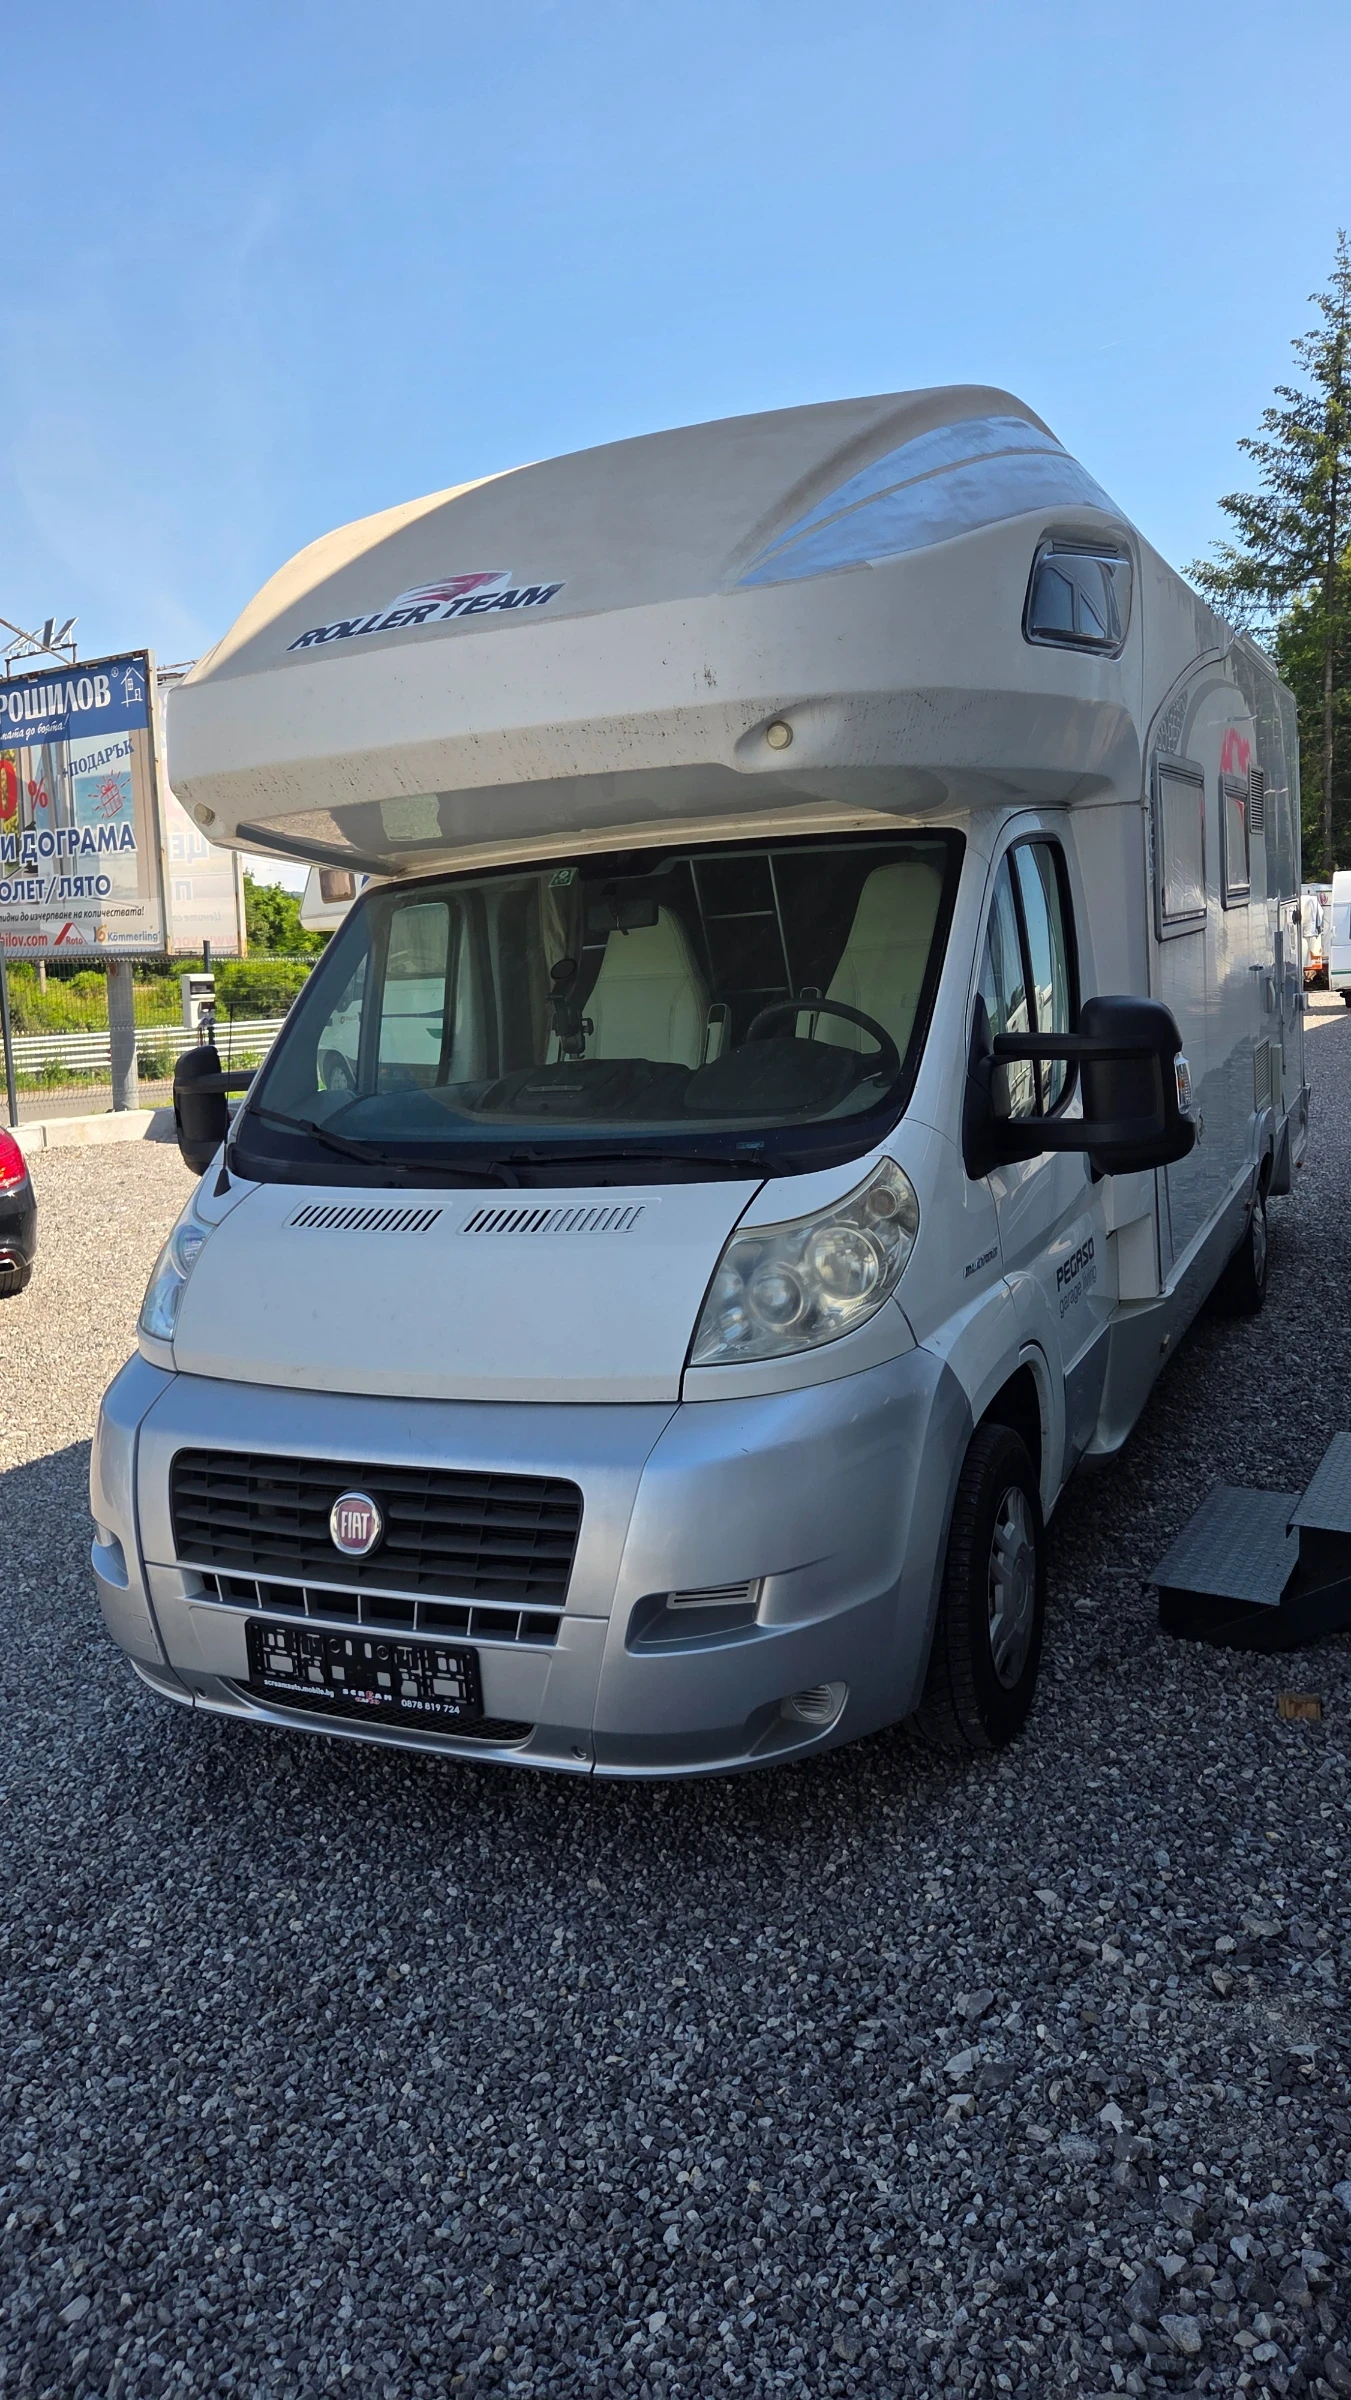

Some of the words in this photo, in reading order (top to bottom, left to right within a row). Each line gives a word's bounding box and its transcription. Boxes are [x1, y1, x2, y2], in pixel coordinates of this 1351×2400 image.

[286, 602, 441, 651] ROLLER
[440, 582, 566, 619] TEAM
[26, 727, 35, 741] до
[20, 822, 137, 864] ДОГРАМА
[20, 911, 29, 921] до
[30, 910, 72, 923] изчерпване
[73, 910, 83, 919] на
[84, 906, 145, 919] количествата!
[66, 936, 84, 946] Roto
[107, 931, 159, 944] Kömmerling
[1056, 1237, 1095, 1292] PEGASO
[1060, 1281, 1082, 1319] garage
[341, 1510, 371, 1540] FIAT
[401, 1699, 423, 1710] 0878
[424, 1702, 441, 1712] 819
[443, 1704, 460, 1714] 724
